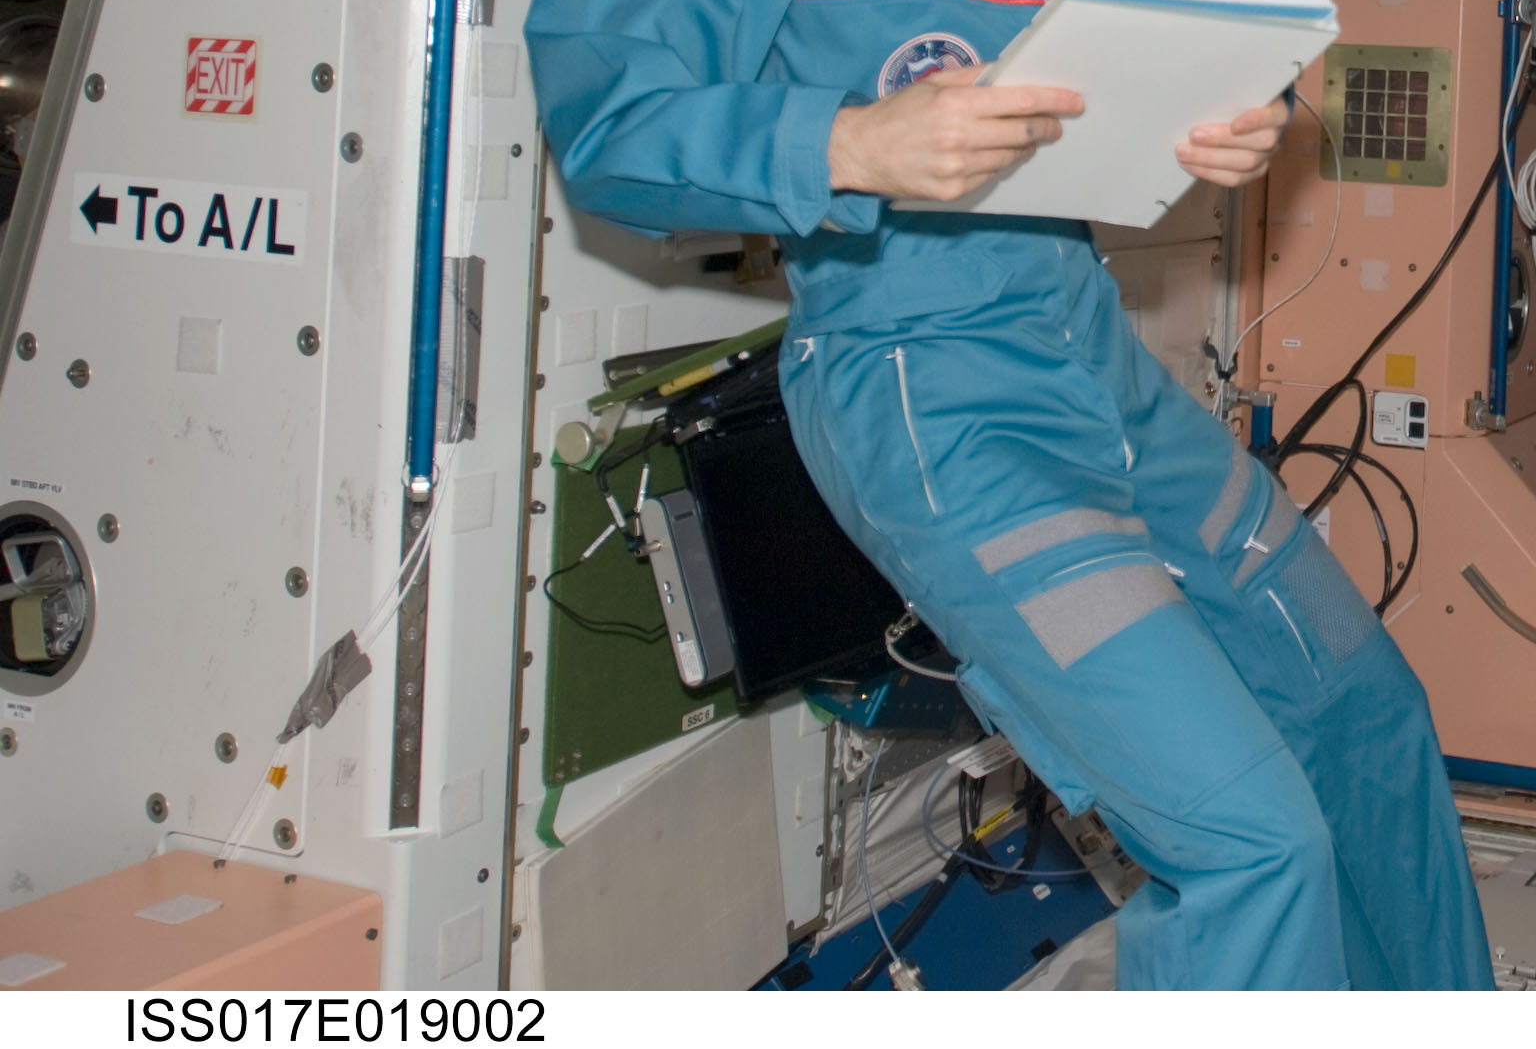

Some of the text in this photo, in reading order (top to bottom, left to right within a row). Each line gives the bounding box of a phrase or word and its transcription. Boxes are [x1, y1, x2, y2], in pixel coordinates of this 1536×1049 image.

[196, 56, 245, 96] EXIT
[127, 185, 295, 256] To A/L
[688, 712, 704, 727] SSC
